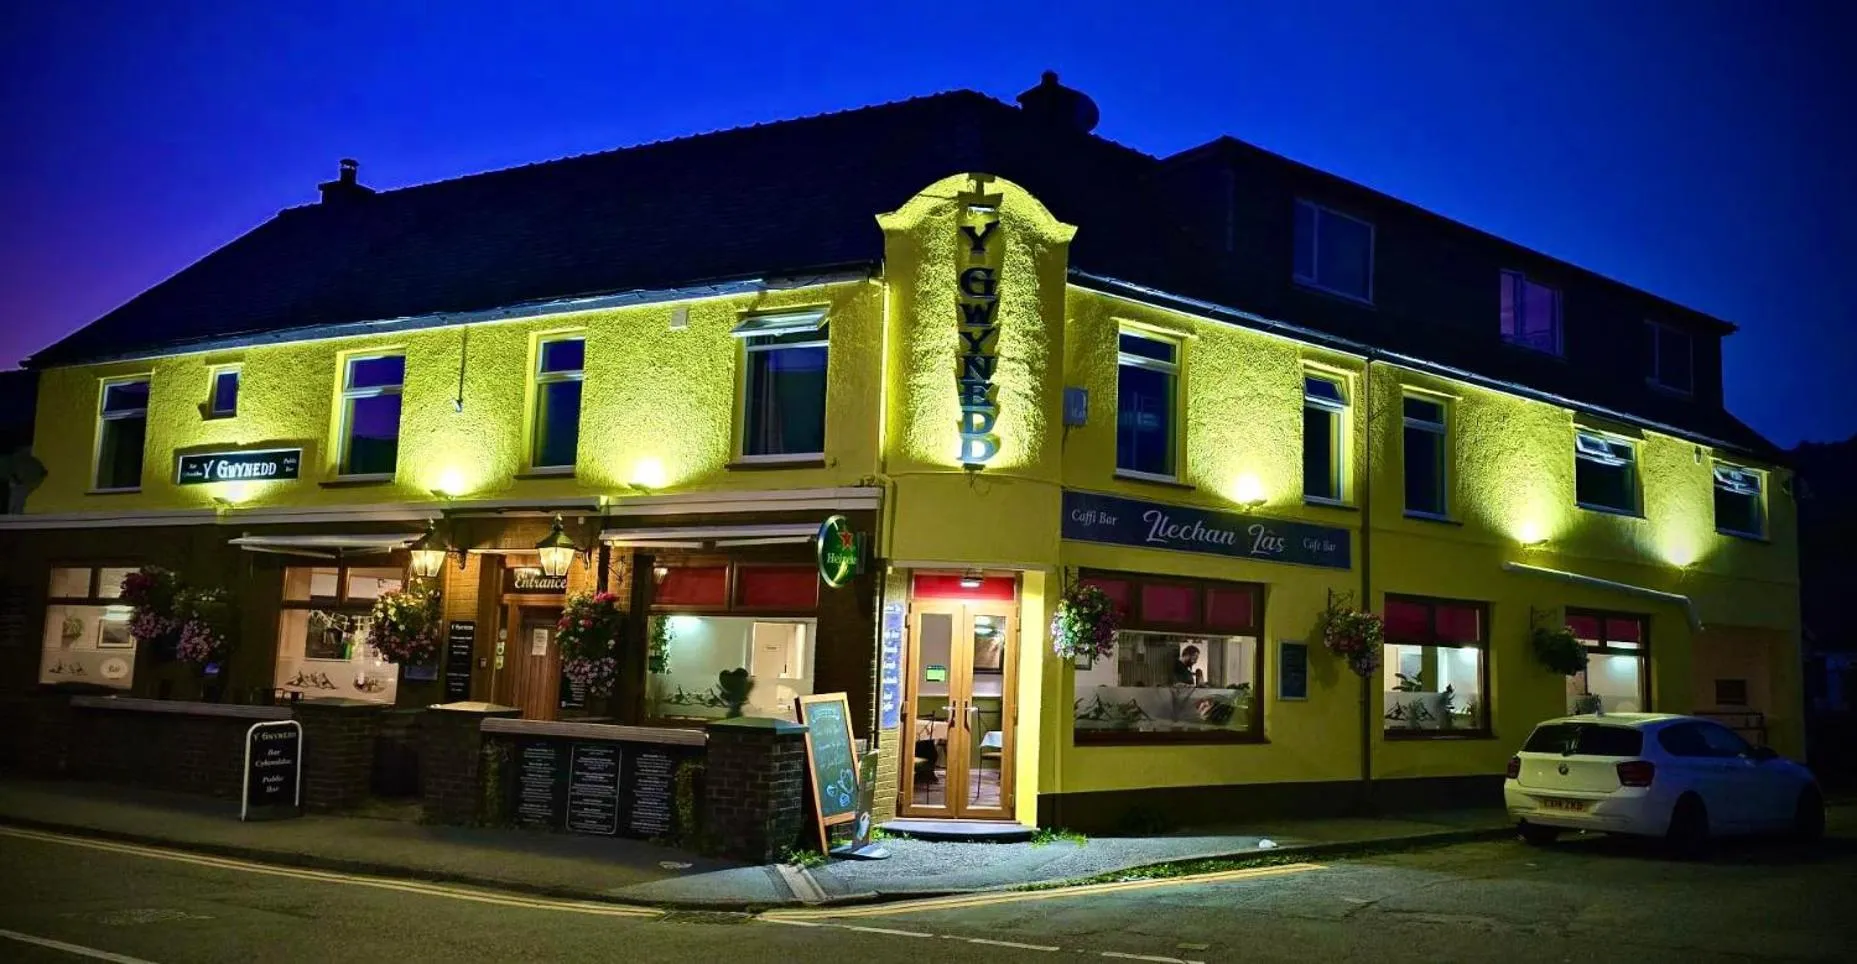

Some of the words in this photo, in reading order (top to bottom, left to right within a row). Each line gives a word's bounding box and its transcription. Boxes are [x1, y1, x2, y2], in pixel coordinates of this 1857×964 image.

[959, 219, 1000, 254] Y
[958, 267, 998, 462] GWYNEDD
[203, 460, 215, 478] Y
[217, 460, 277, 479] GWYNEDD
[1071, 509, 1097, 527] Caffi
[1099, 511, 1120, 526] Bar
[1143, 509, 1236, 546] Llechan
[514, 572, 568, 589] Entrance
